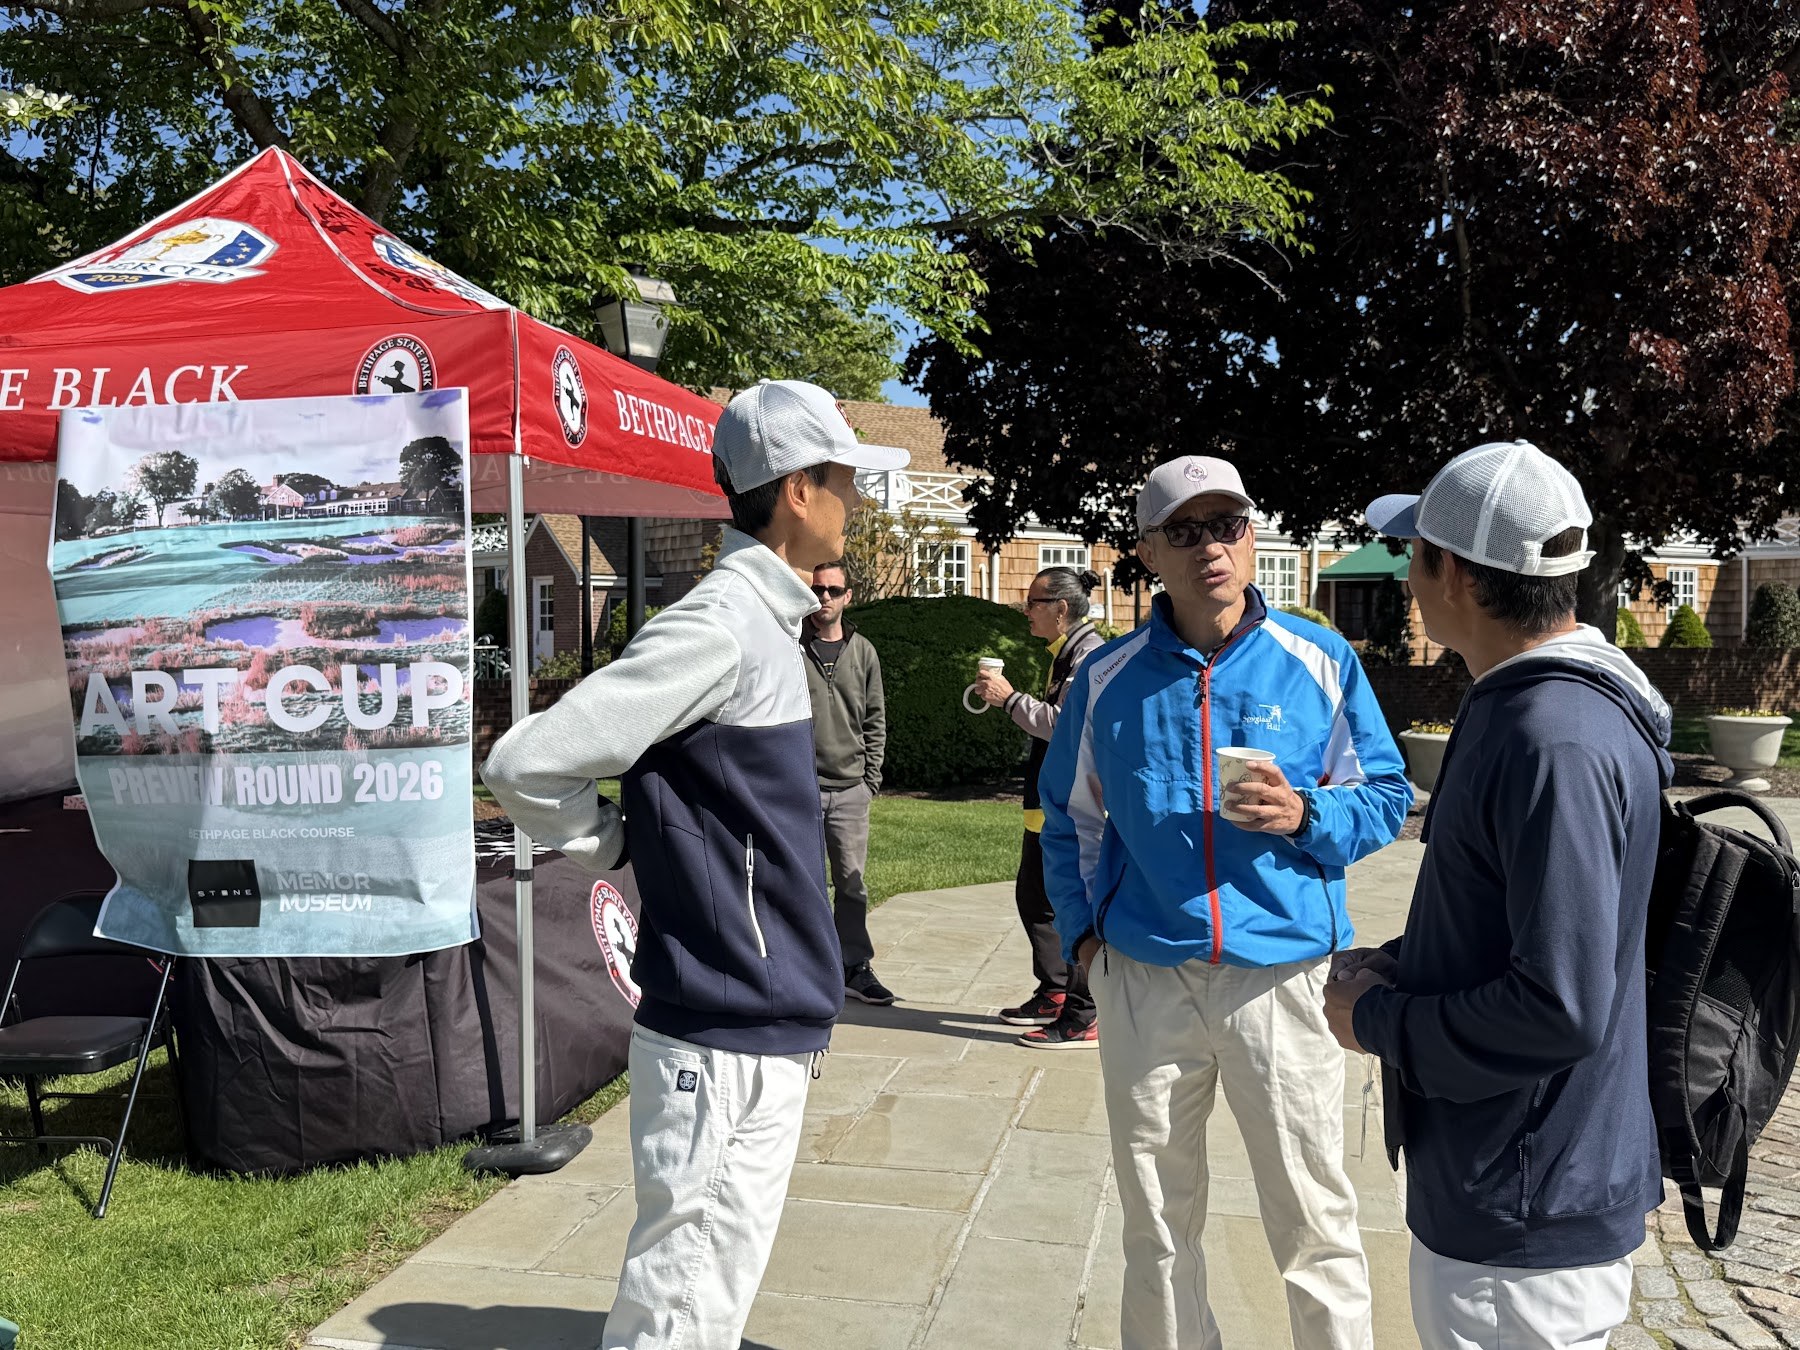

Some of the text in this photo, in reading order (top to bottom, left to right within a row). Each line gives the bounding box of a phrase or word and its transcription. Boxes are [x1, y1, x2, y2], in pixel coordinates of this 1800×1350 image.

[85, 274, 143, 283] 2025
[159, 265, 235, 277] CUP
[358, 338, 432, 388] BETHPAGE STATE PARK
[47, 365, 248, 411] BLACK
[613, 389, 712, 455] BETHPAGE
[79, 662, 464, 736] ART CUP
[108, 760, 444, 806] PREVIEW ROUND 2026
[189, 827, 355, 840] BETHPAGE BLACK COURSE
[276, 871, 371, 890] MEMOR
[280, 893, 372, 912] MUSEUM
